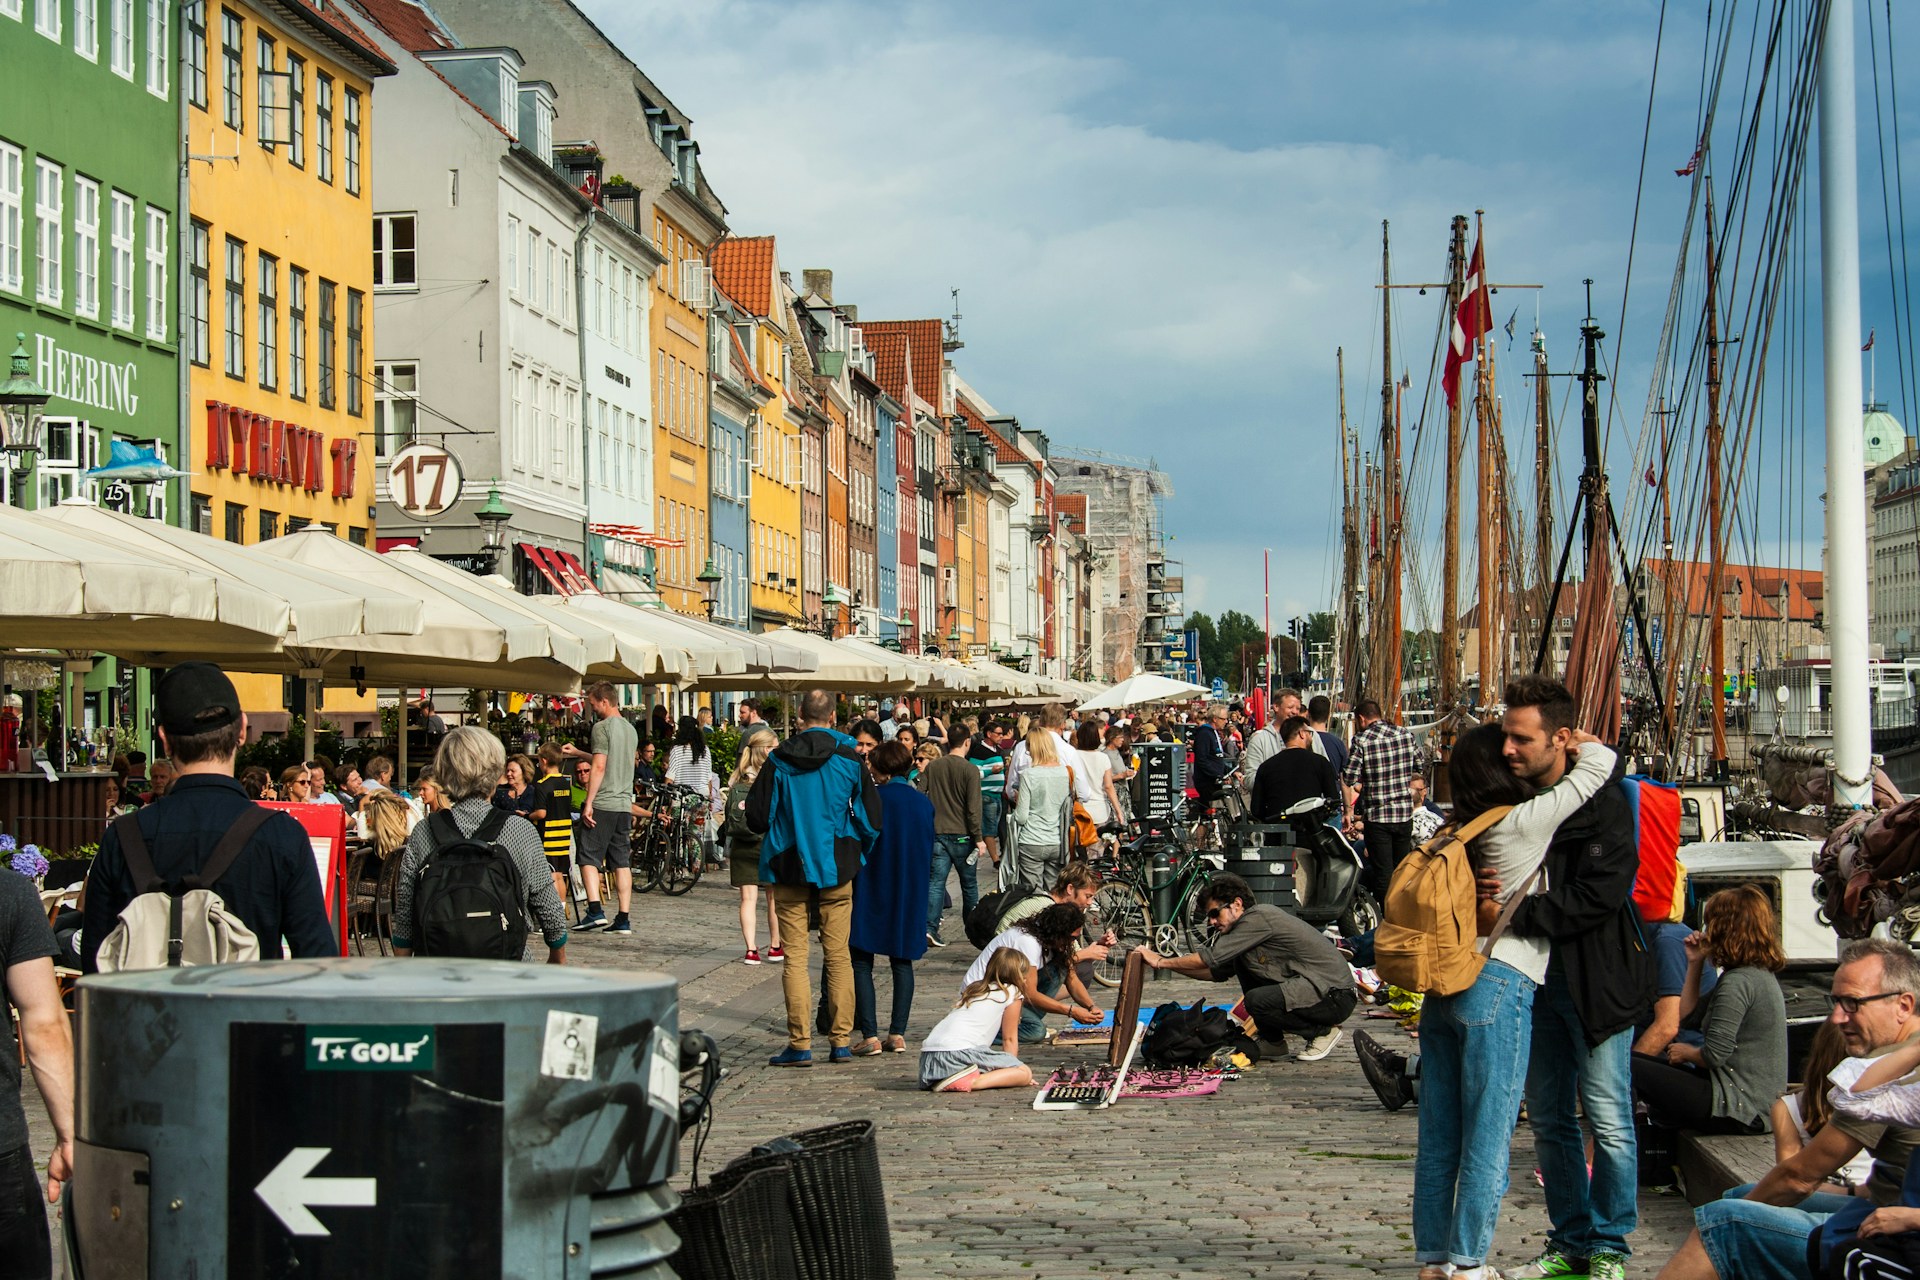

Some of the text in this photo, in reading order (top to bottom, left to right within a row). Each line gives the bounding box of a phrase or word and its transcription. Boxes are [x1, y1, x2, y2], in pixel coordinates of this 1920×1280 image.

[35, 333, 139, 417] HEERING
[105, 485, 123, 501] 15
[393, 454, 449, 511] 17
